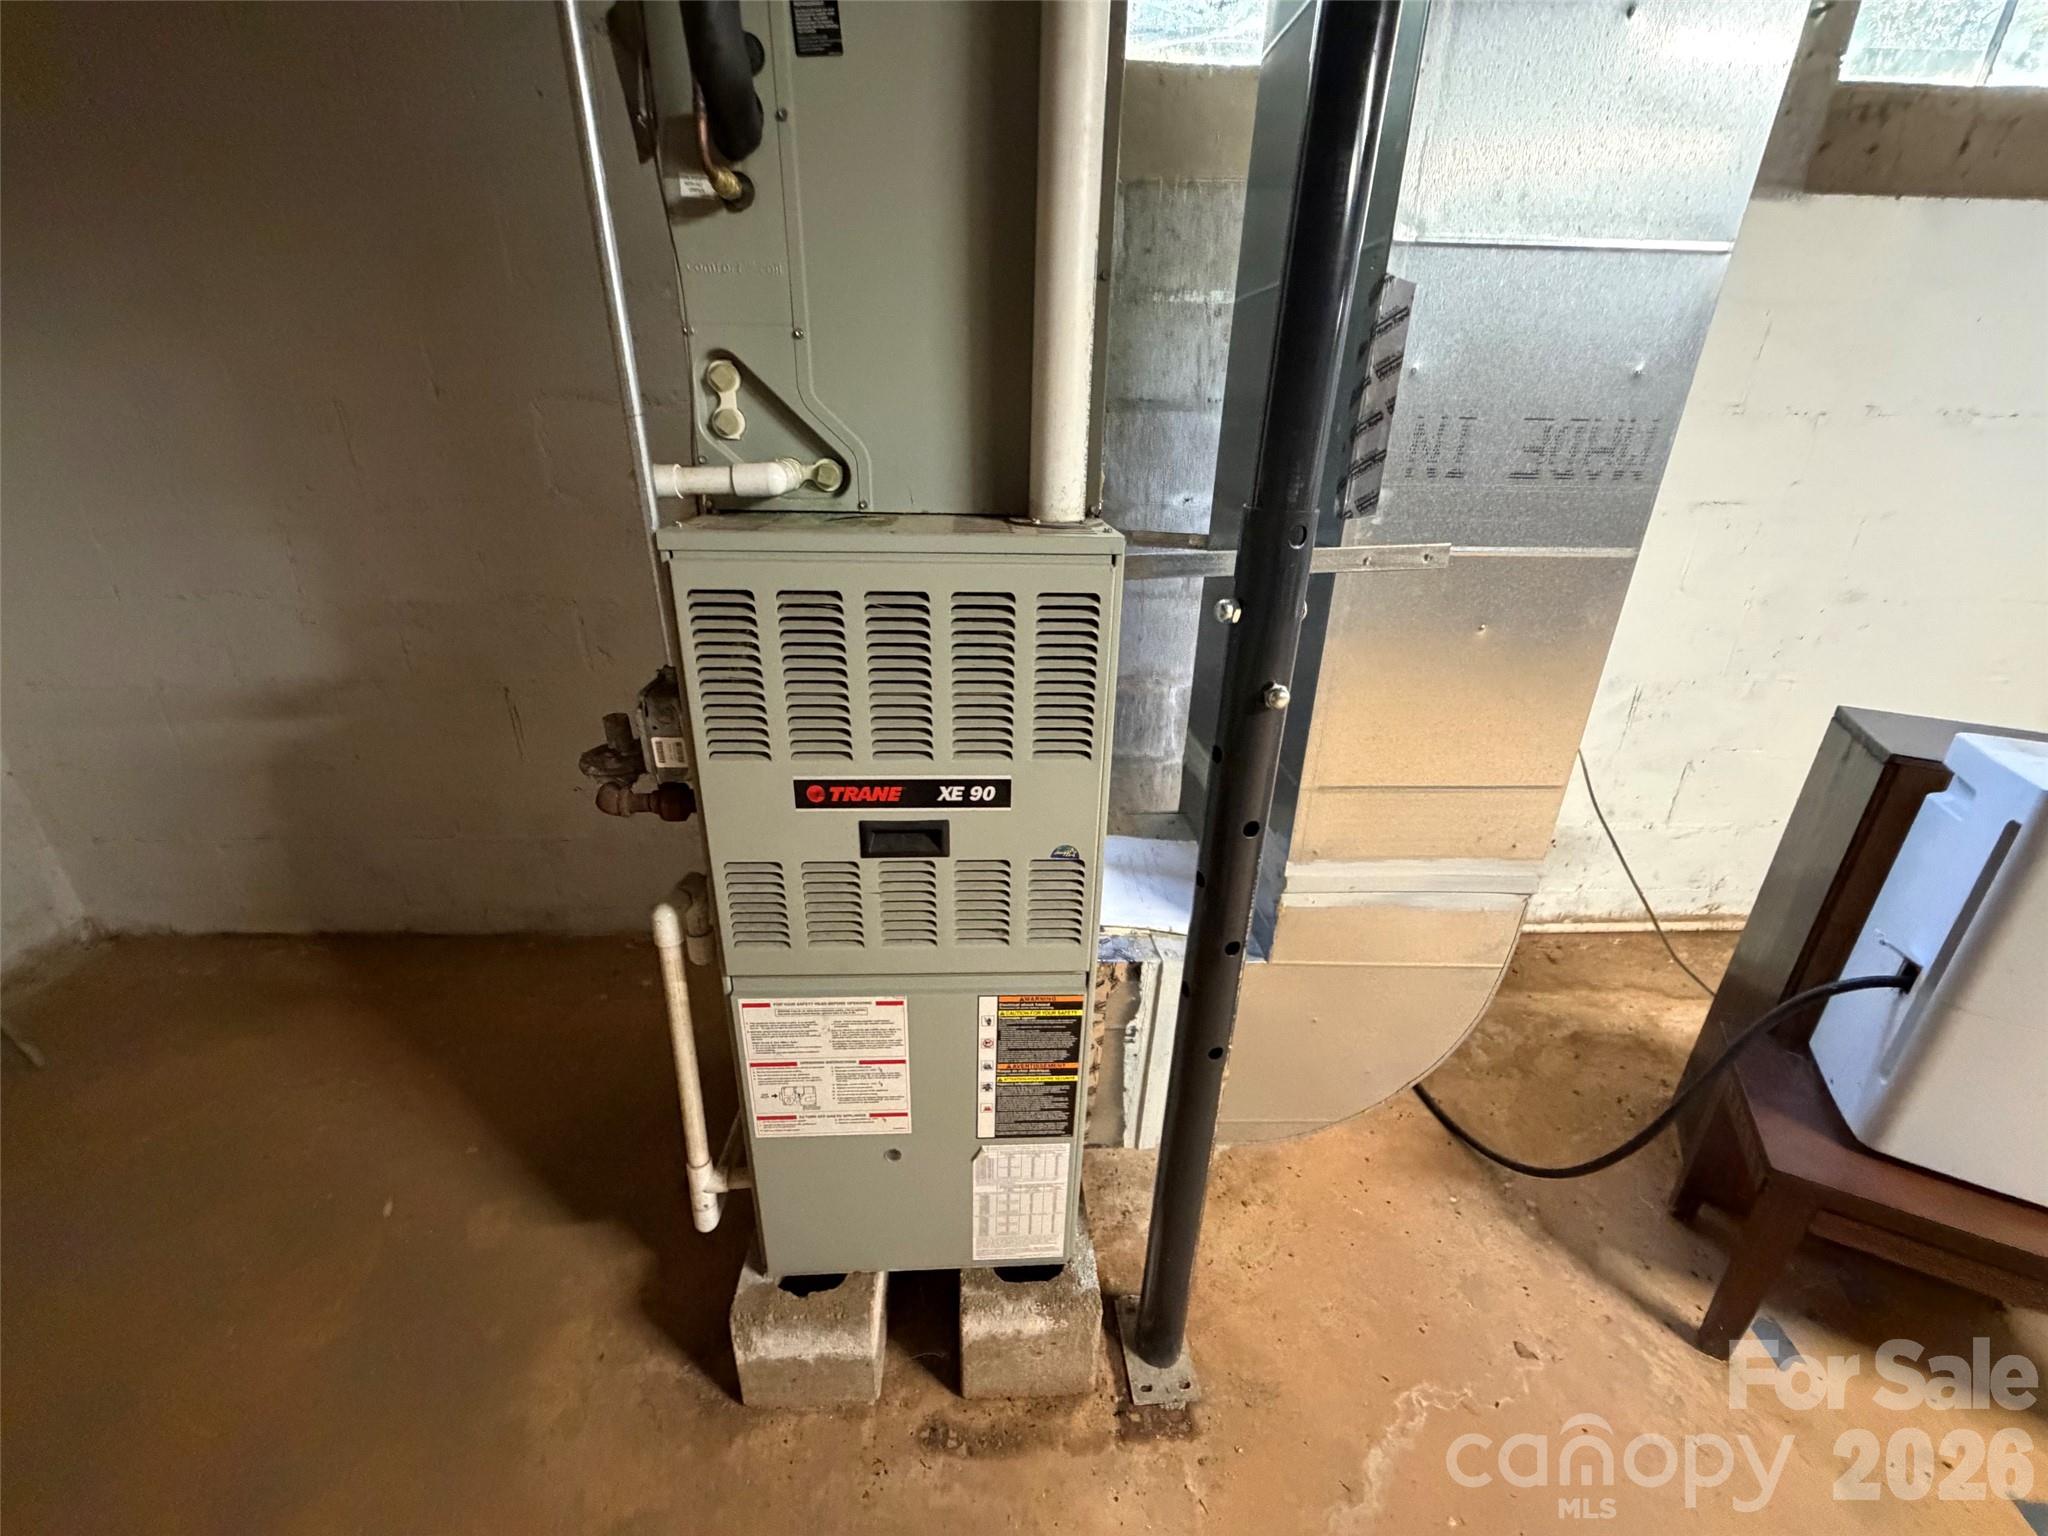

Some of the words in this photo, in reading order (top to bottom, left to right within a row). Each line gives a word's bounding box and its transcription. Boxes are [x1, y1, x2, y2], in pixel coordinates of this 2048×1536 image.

[829, 786, 904, 802] TRANE
[937, 786, 965, 801] XE
[969, 786, 996, 801] 90
